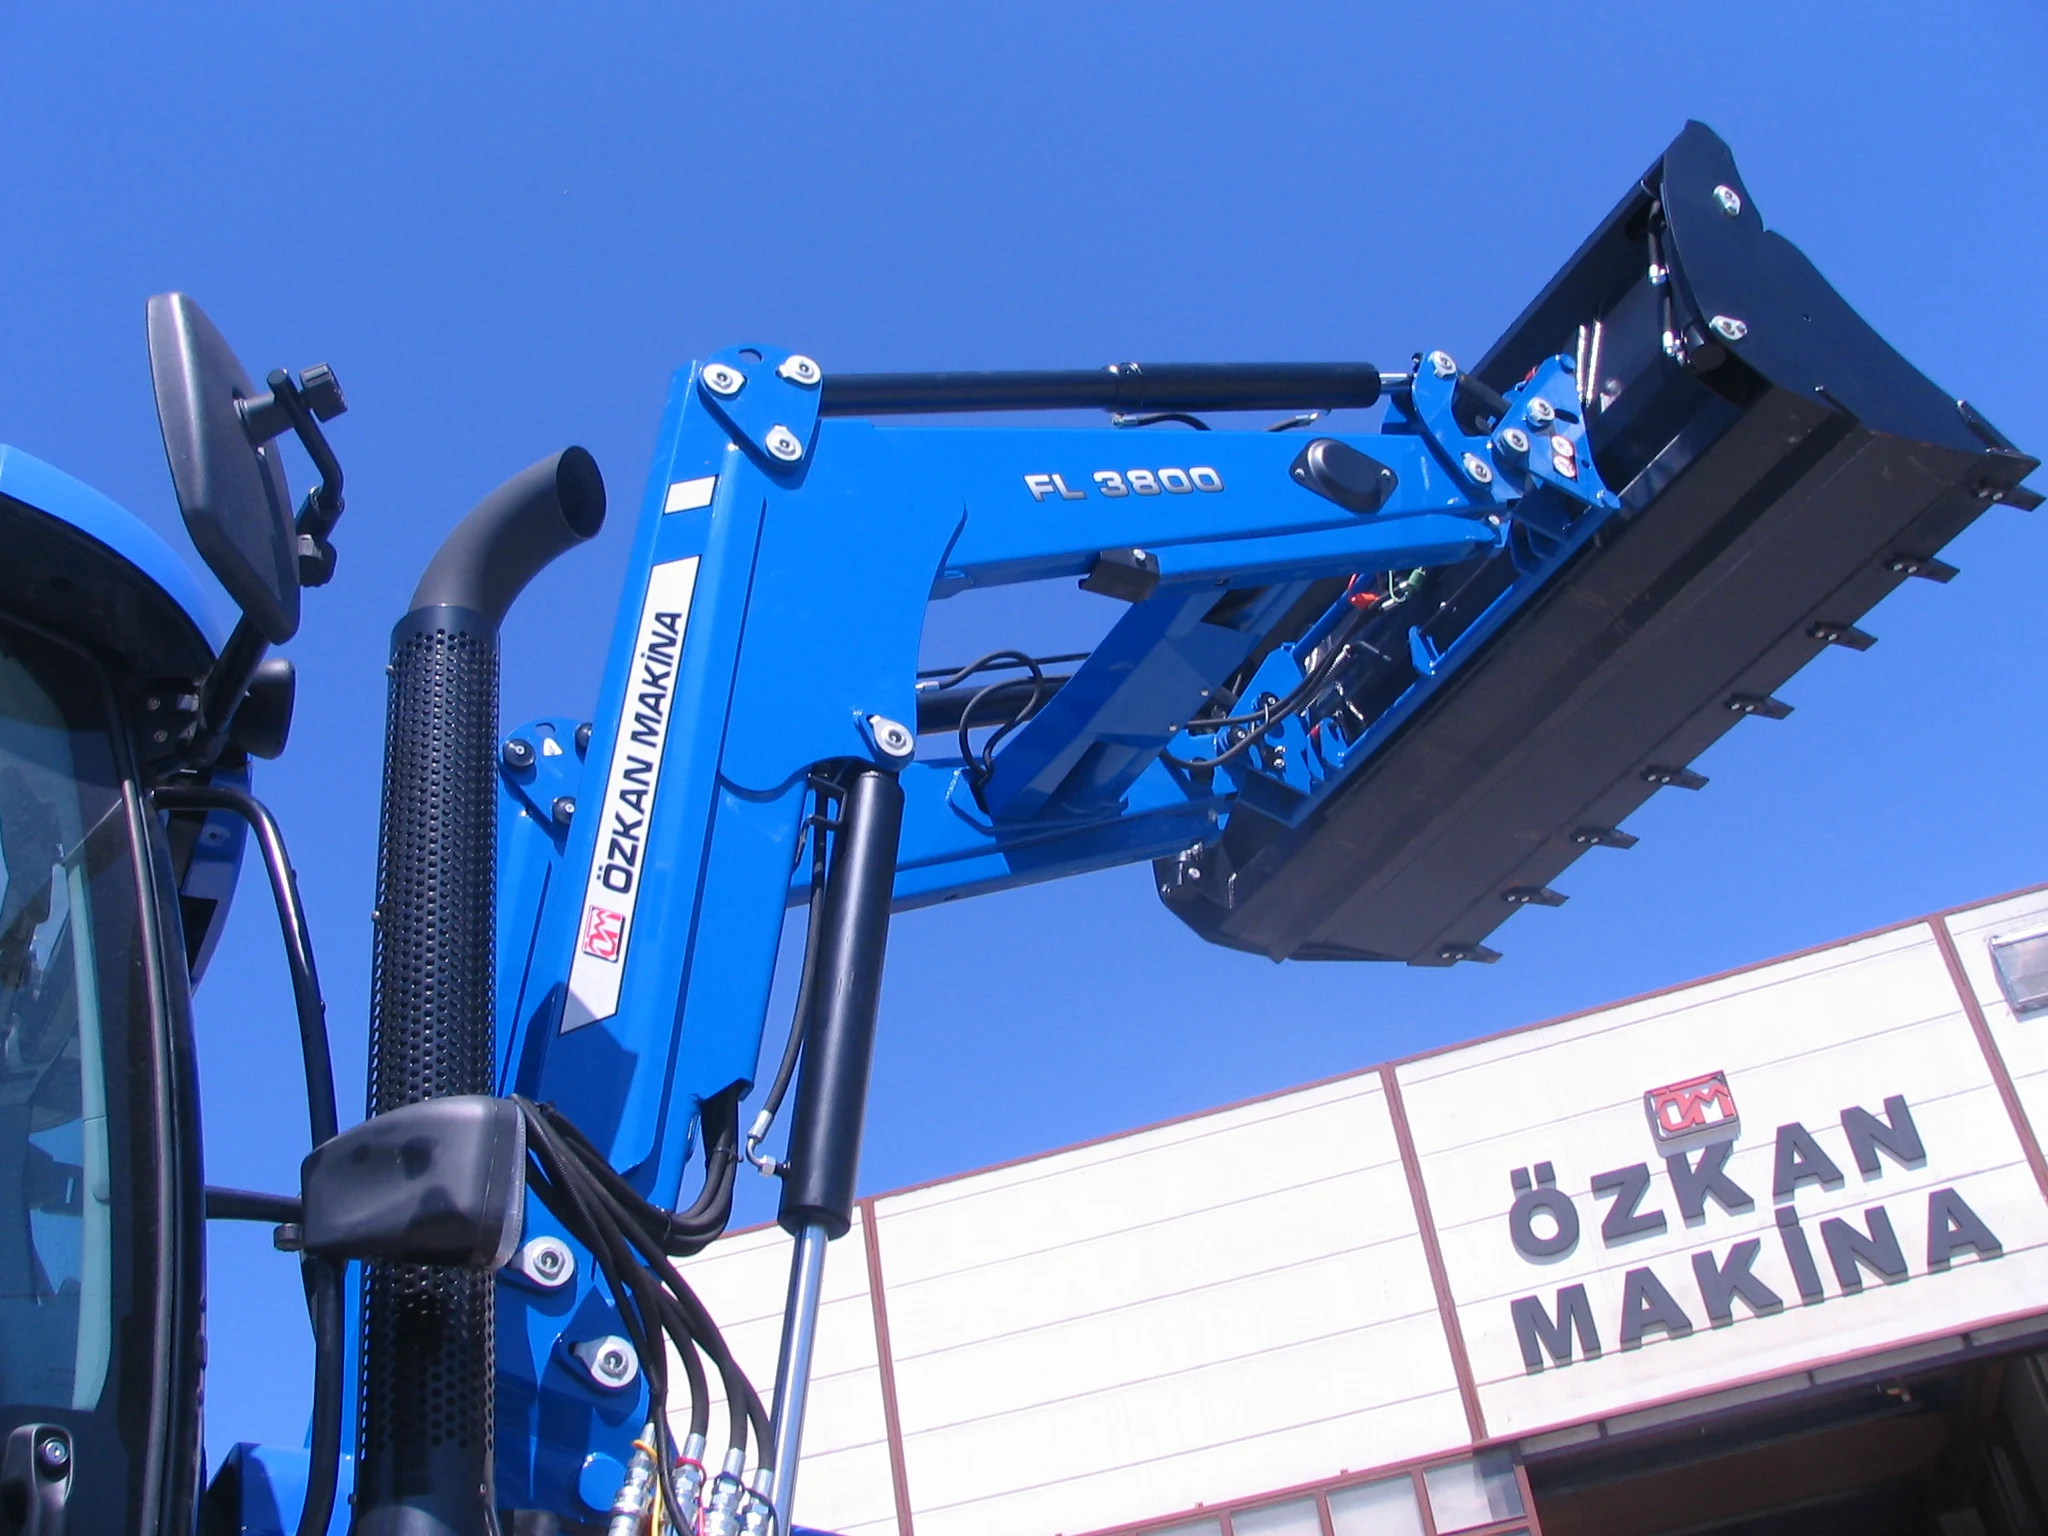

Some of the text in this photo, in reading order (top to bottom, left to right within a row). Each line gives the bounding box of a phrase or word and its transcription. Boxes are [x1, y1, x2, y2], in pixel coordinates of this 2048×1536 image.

[1023, 466, 1224, 502] FL 3800
[596, 611, 683, 895] ÖZKAN MAKİNA
[1509, 1094, 1927, 1265] ÖZKAN
[1510, 1187, 2003, 1376] MAKİNA
